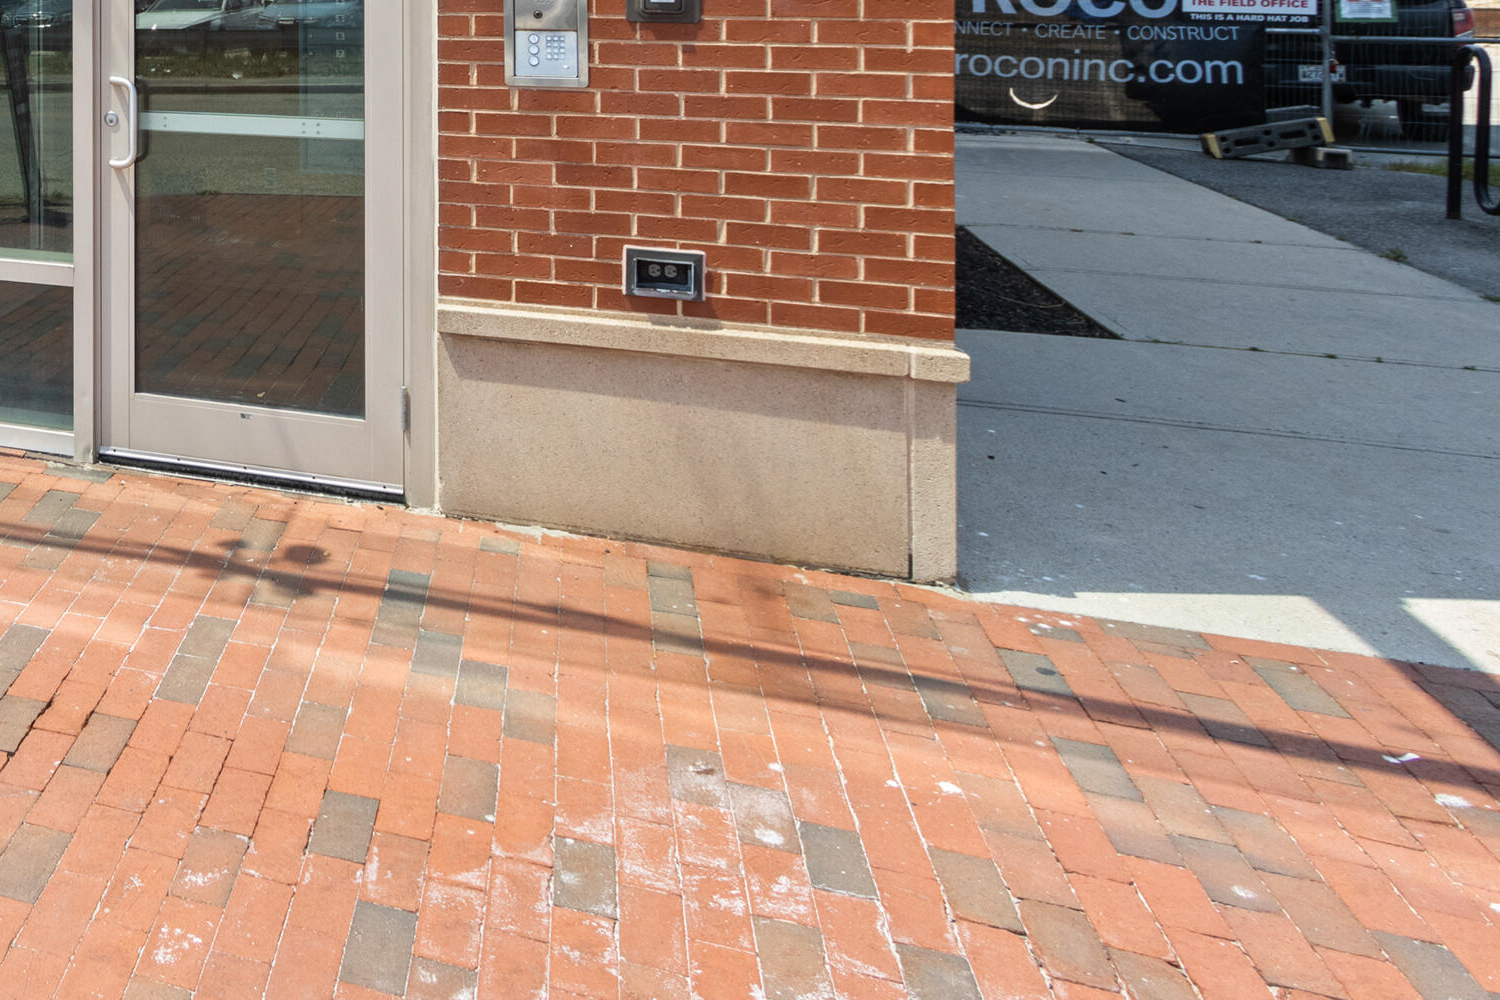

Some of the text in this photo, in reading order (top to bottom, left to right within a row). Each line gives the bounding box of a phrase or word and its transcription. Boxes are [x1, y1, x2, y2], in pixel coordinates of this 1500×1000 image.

[1220, 0, 1257, 7] FIELD
[1260, 0, 1309, 8] OFFICE
[1289, 15, 1309, 23] JOB
[1035, 23, 1107, 40] CREATE
[1126, 25, 1241, 41] CONSTRUCT
